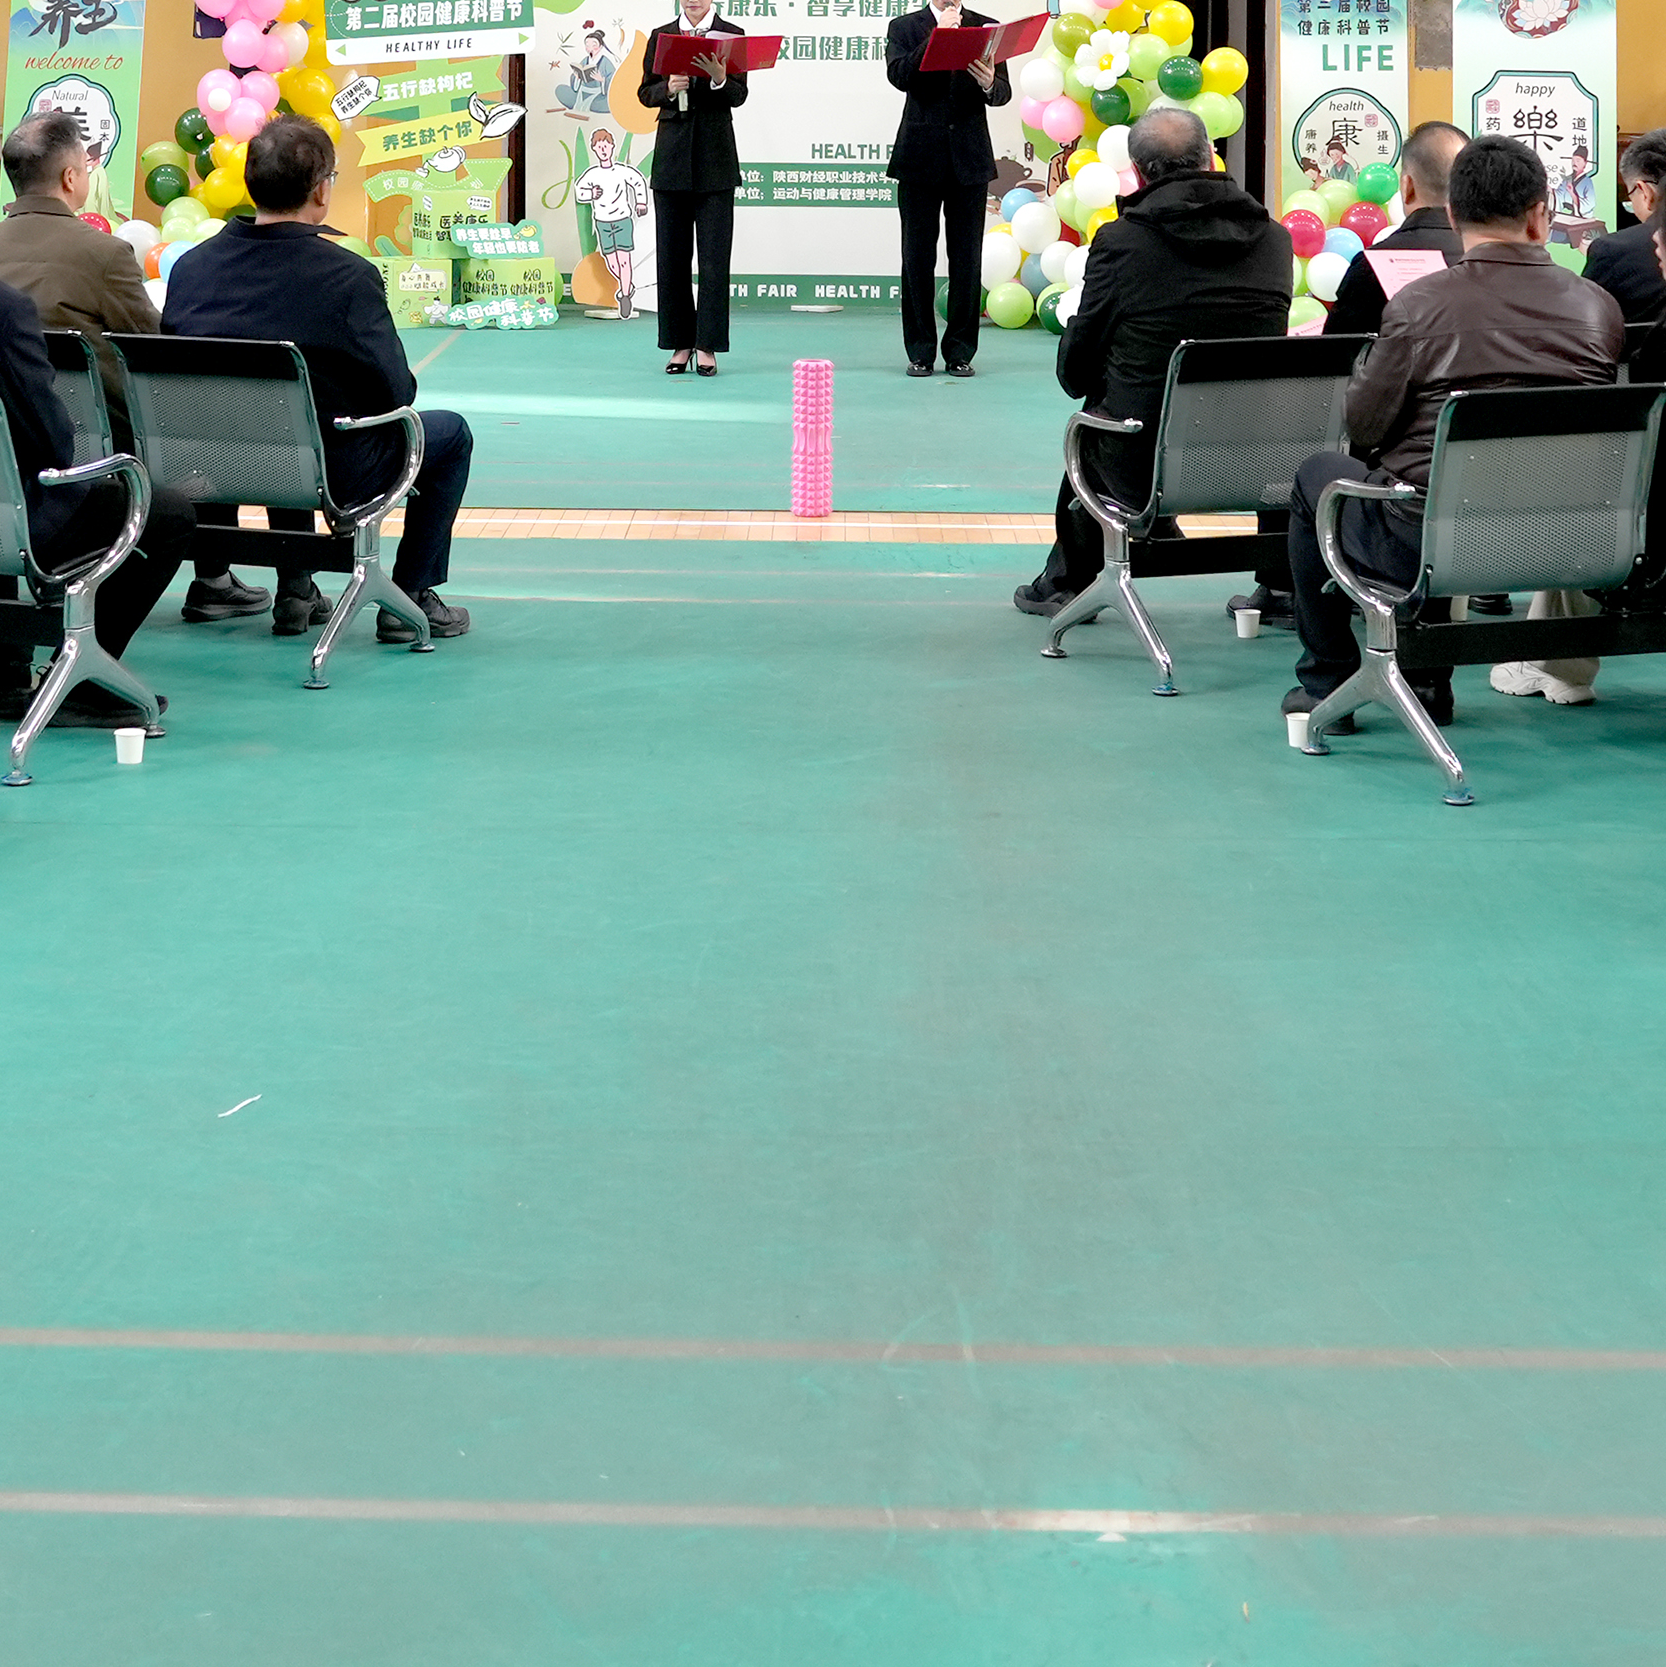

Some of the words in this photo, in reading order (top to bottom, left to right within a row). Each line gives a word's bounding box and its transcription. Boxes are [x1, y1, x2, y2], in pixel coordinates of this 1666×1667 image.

[1298, 19, 1390, 36] 健康科普节
[385, 40, 442, 53] HEALTHY
[447, 38, 473, 50] LIFE
[25, 52, 100, 70] welcome
[104, 54, 123, 70] to
[1322, 44, 1394, 72] LIFE
[382, 72, 473, 102] 五行缺枸杞
[1515, 82, 1556, 97] happy
[52, 90, 89, 101] Natural
[1329, 101, 1364, 111] health
[1326, 118, 1364, 147] 康
[1486, 117, 1501, 132] 药
[382, 122, 473, 151] 养生缺个你
[811, 144, 880, 159] HEALTH
[757, 284, 797, 297] FAIR
[815, 285, 880, 298] HEALTH
[448, 298, 520, 322] 校园健康
